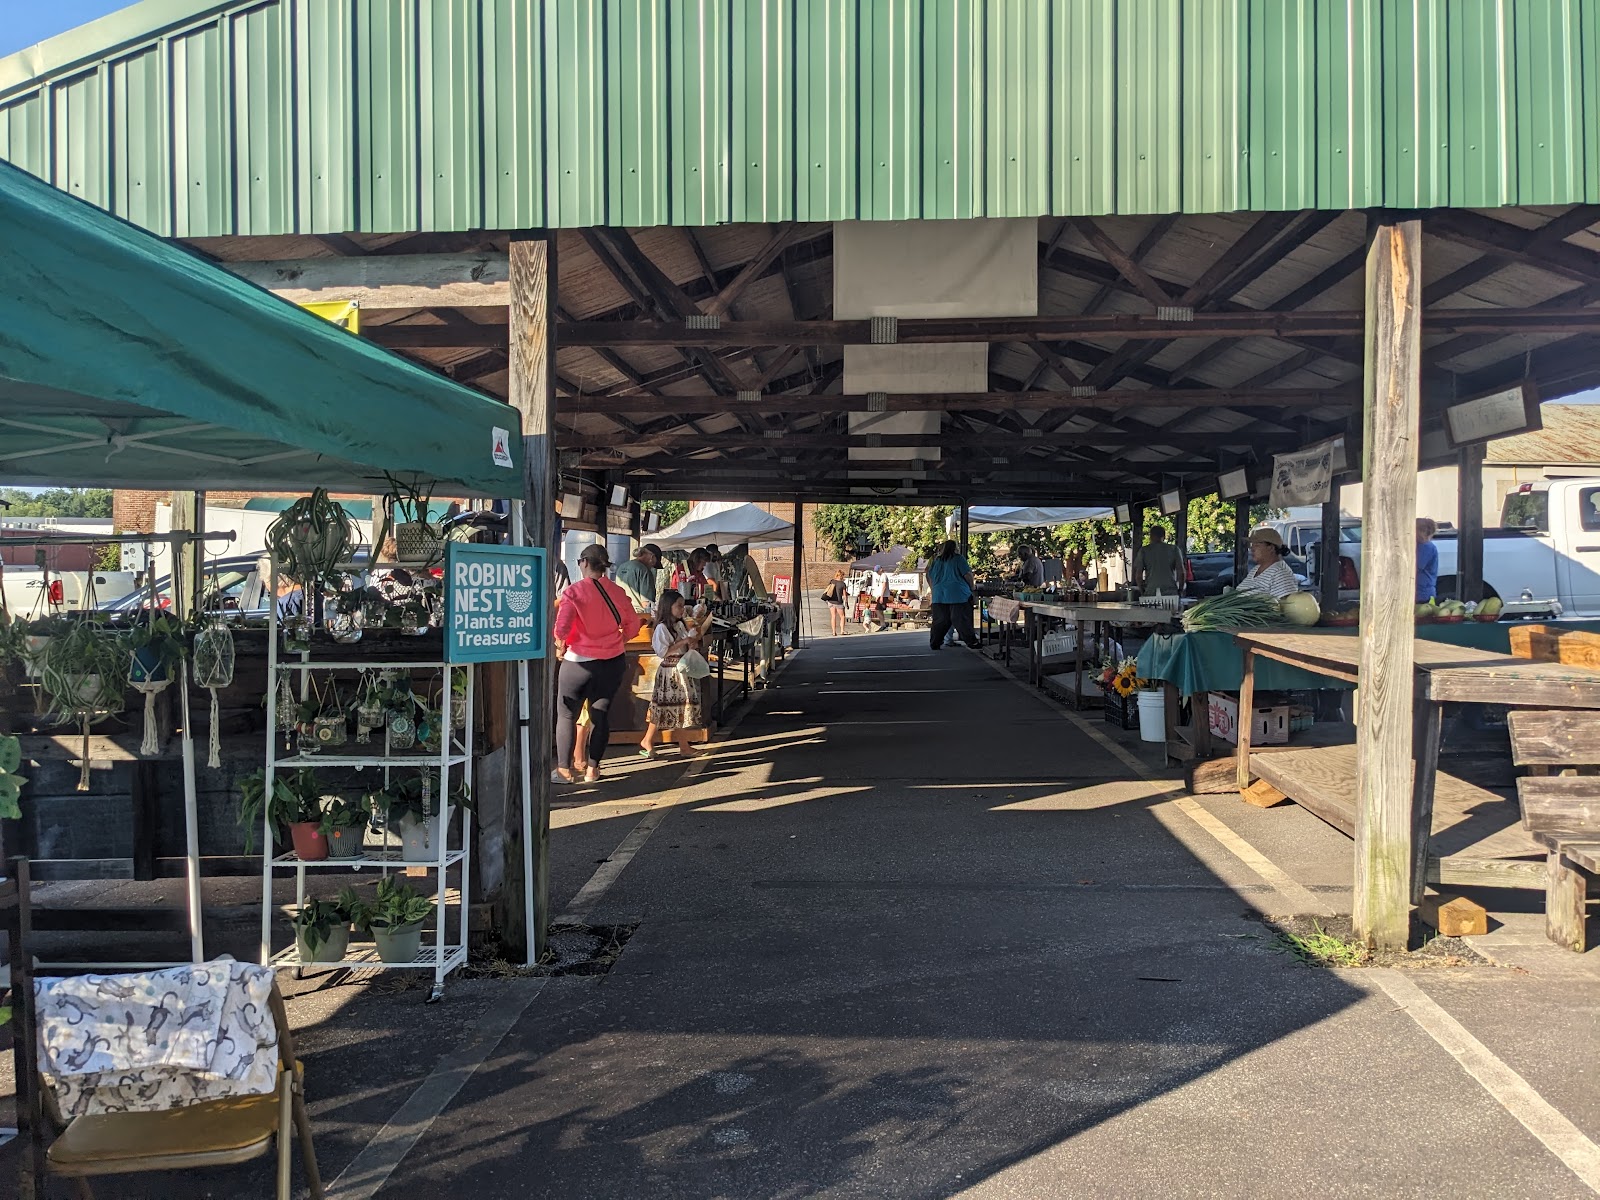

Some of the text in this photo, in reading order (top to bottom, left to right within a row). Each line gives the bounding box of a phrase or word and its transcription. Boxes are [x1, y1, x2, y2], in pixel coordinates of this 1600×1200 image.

[455, 562, 532, 587] ROBIN'S
[455, 588, 505, 613] NEST
[455, 613, 533, 629] Plants and
[456, 630, 531, 647] Treasures
